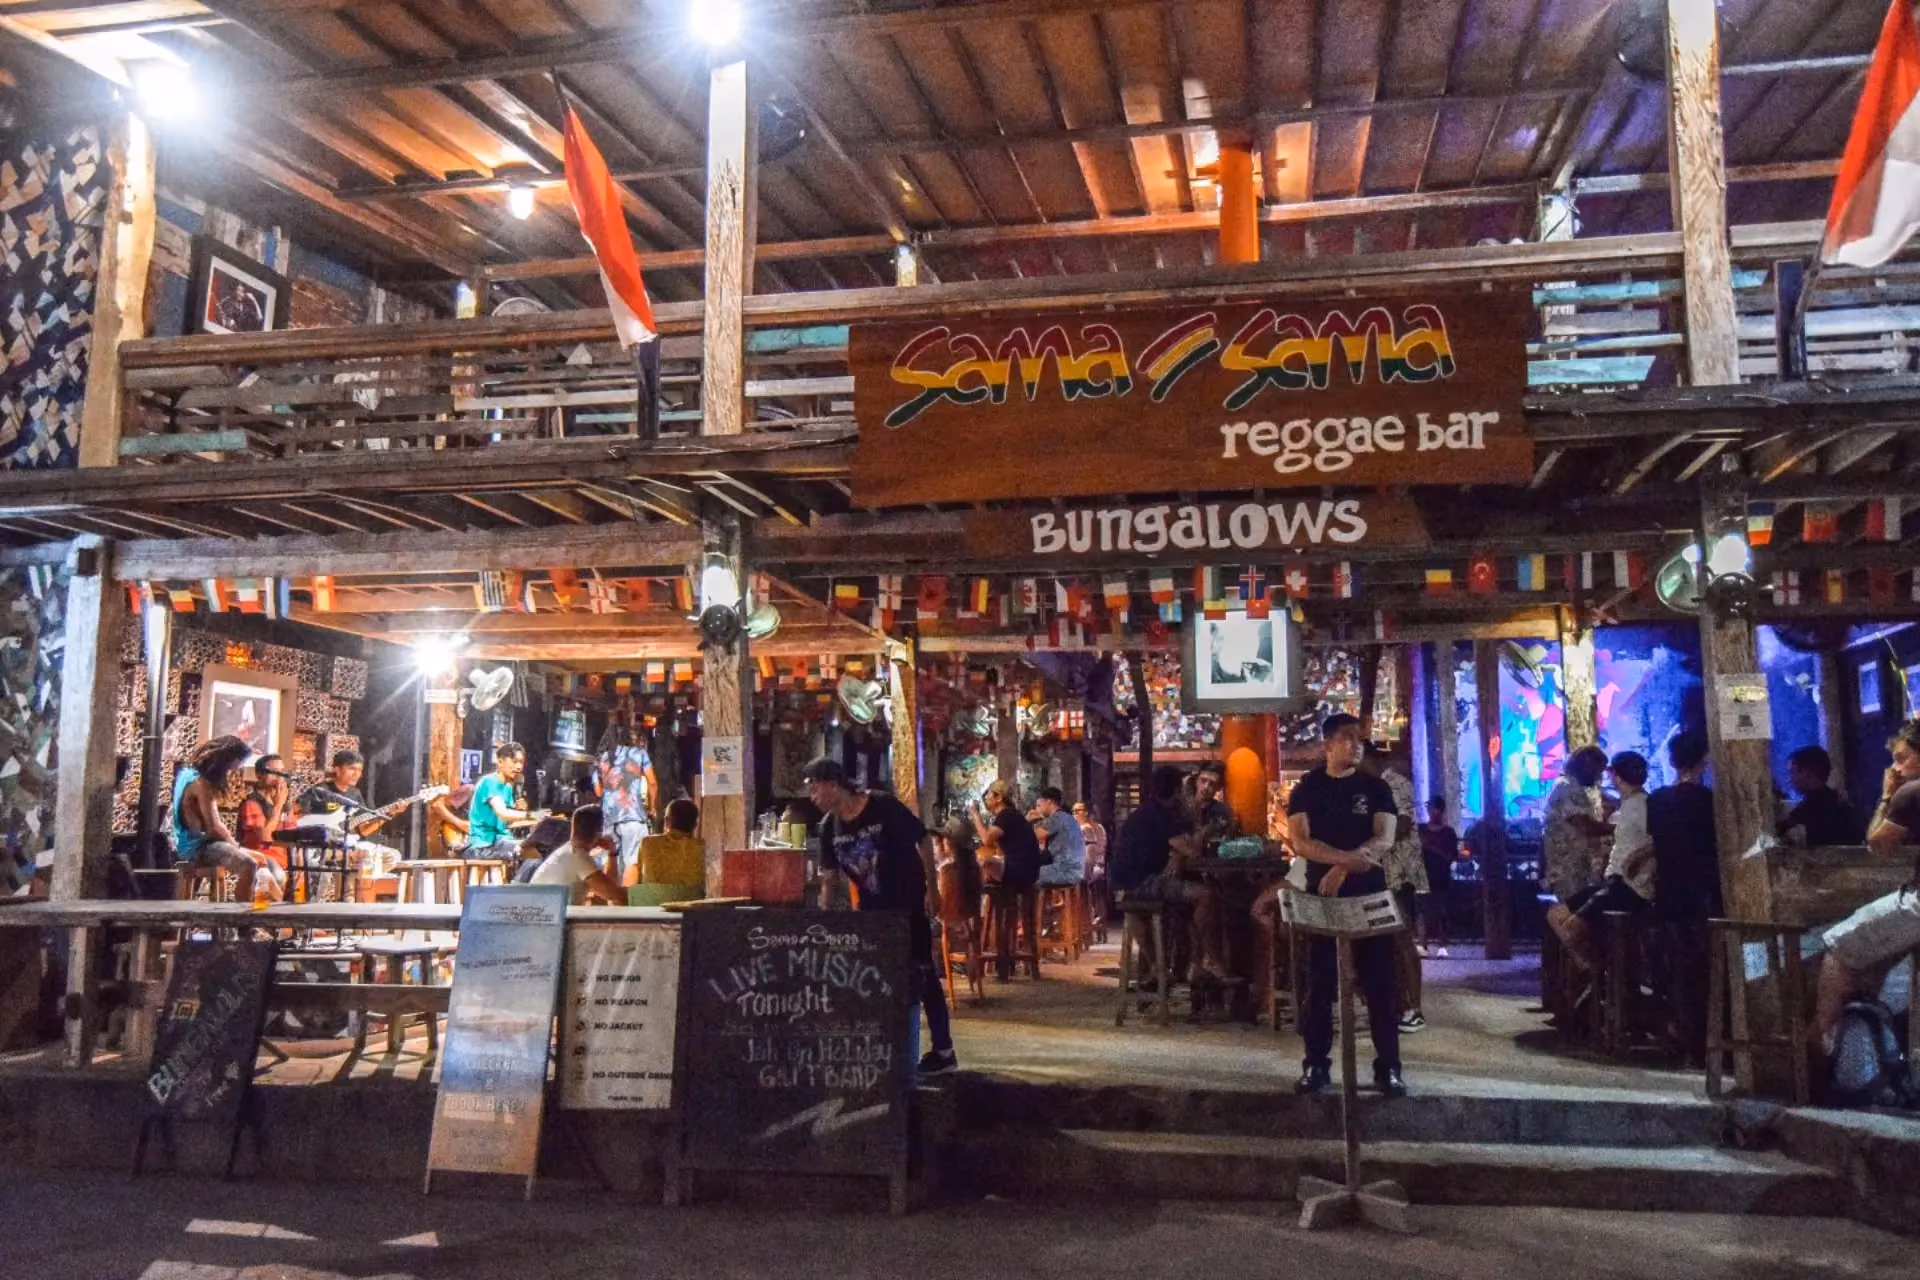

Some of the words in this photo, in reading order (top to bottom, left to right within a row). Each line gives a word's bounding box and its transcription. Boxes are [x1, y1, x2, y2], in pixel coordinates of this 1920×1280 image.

[1221, 417, 1404, 473] reggae
[1417, 411, 1499, 450] bar
[708, 953, 777, 1002] LIVE
[736, 984, 834, 1024] Tonight
